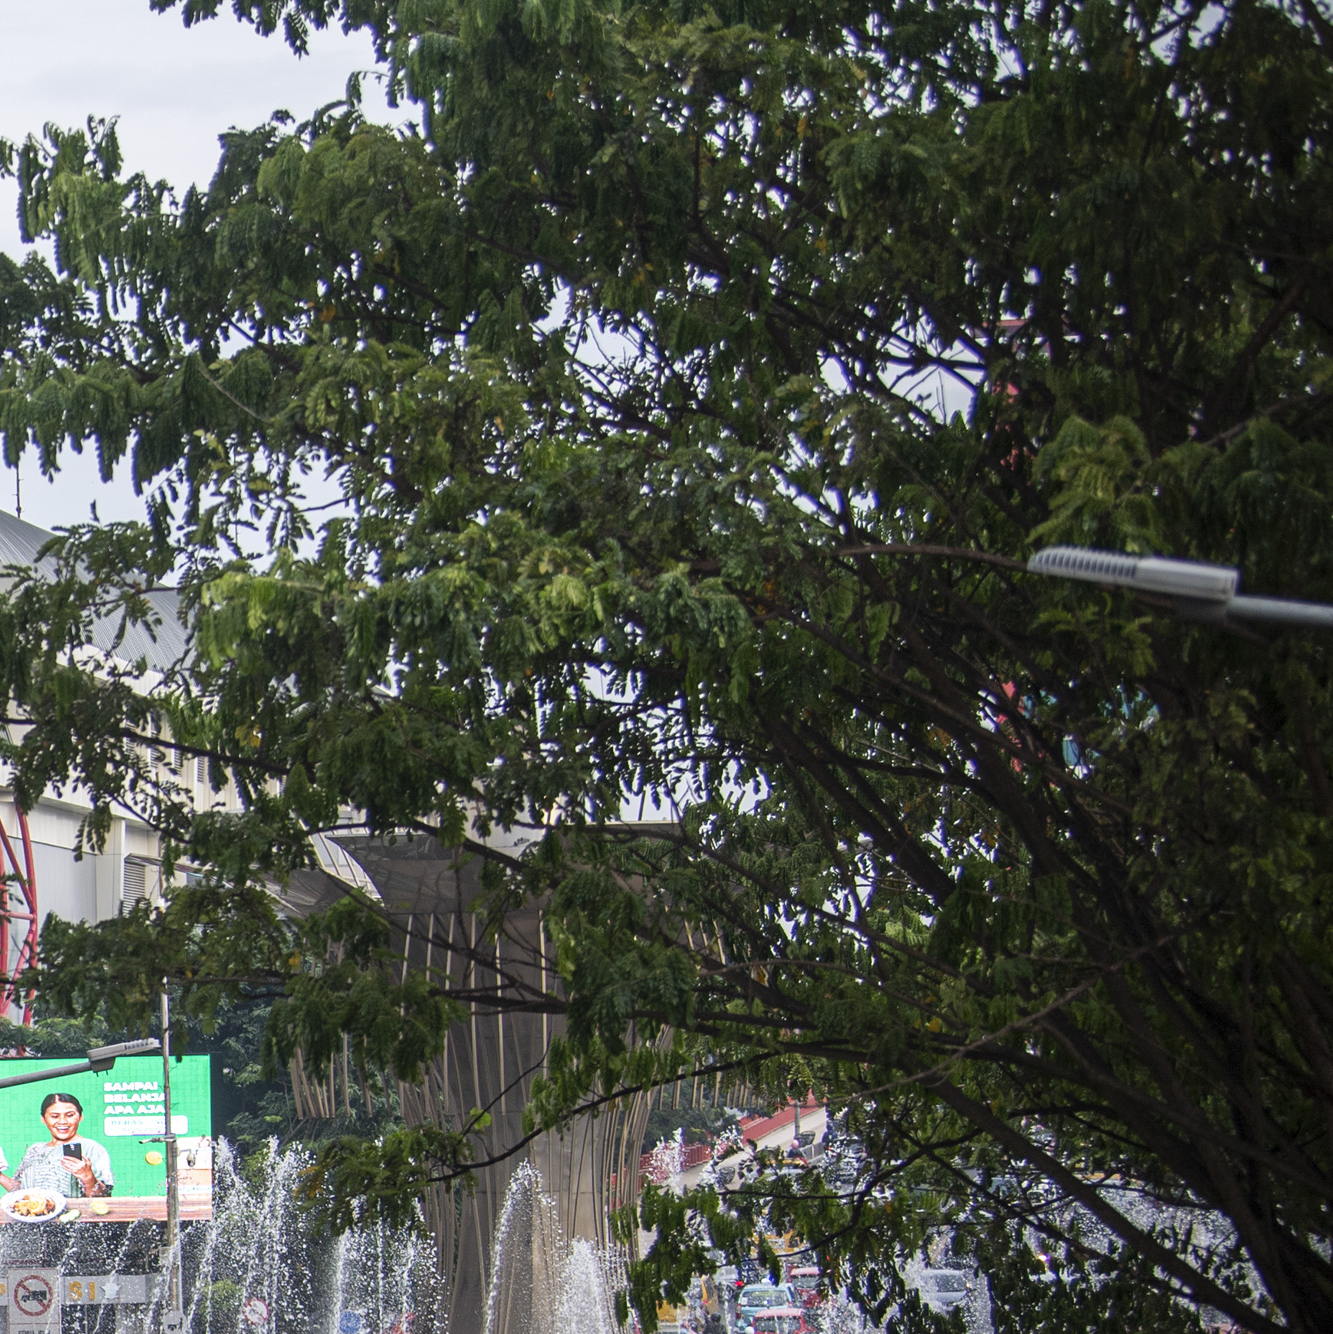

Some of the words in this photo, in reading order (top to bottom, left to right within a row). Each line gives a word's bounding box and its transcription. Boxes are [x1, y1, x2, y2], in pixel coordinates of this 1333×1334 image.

[103, 1082, 158, 1092] SAMPAI
[104, 1105, 135, 1115] APA
[137, 1105, 165, 1114] AJA
